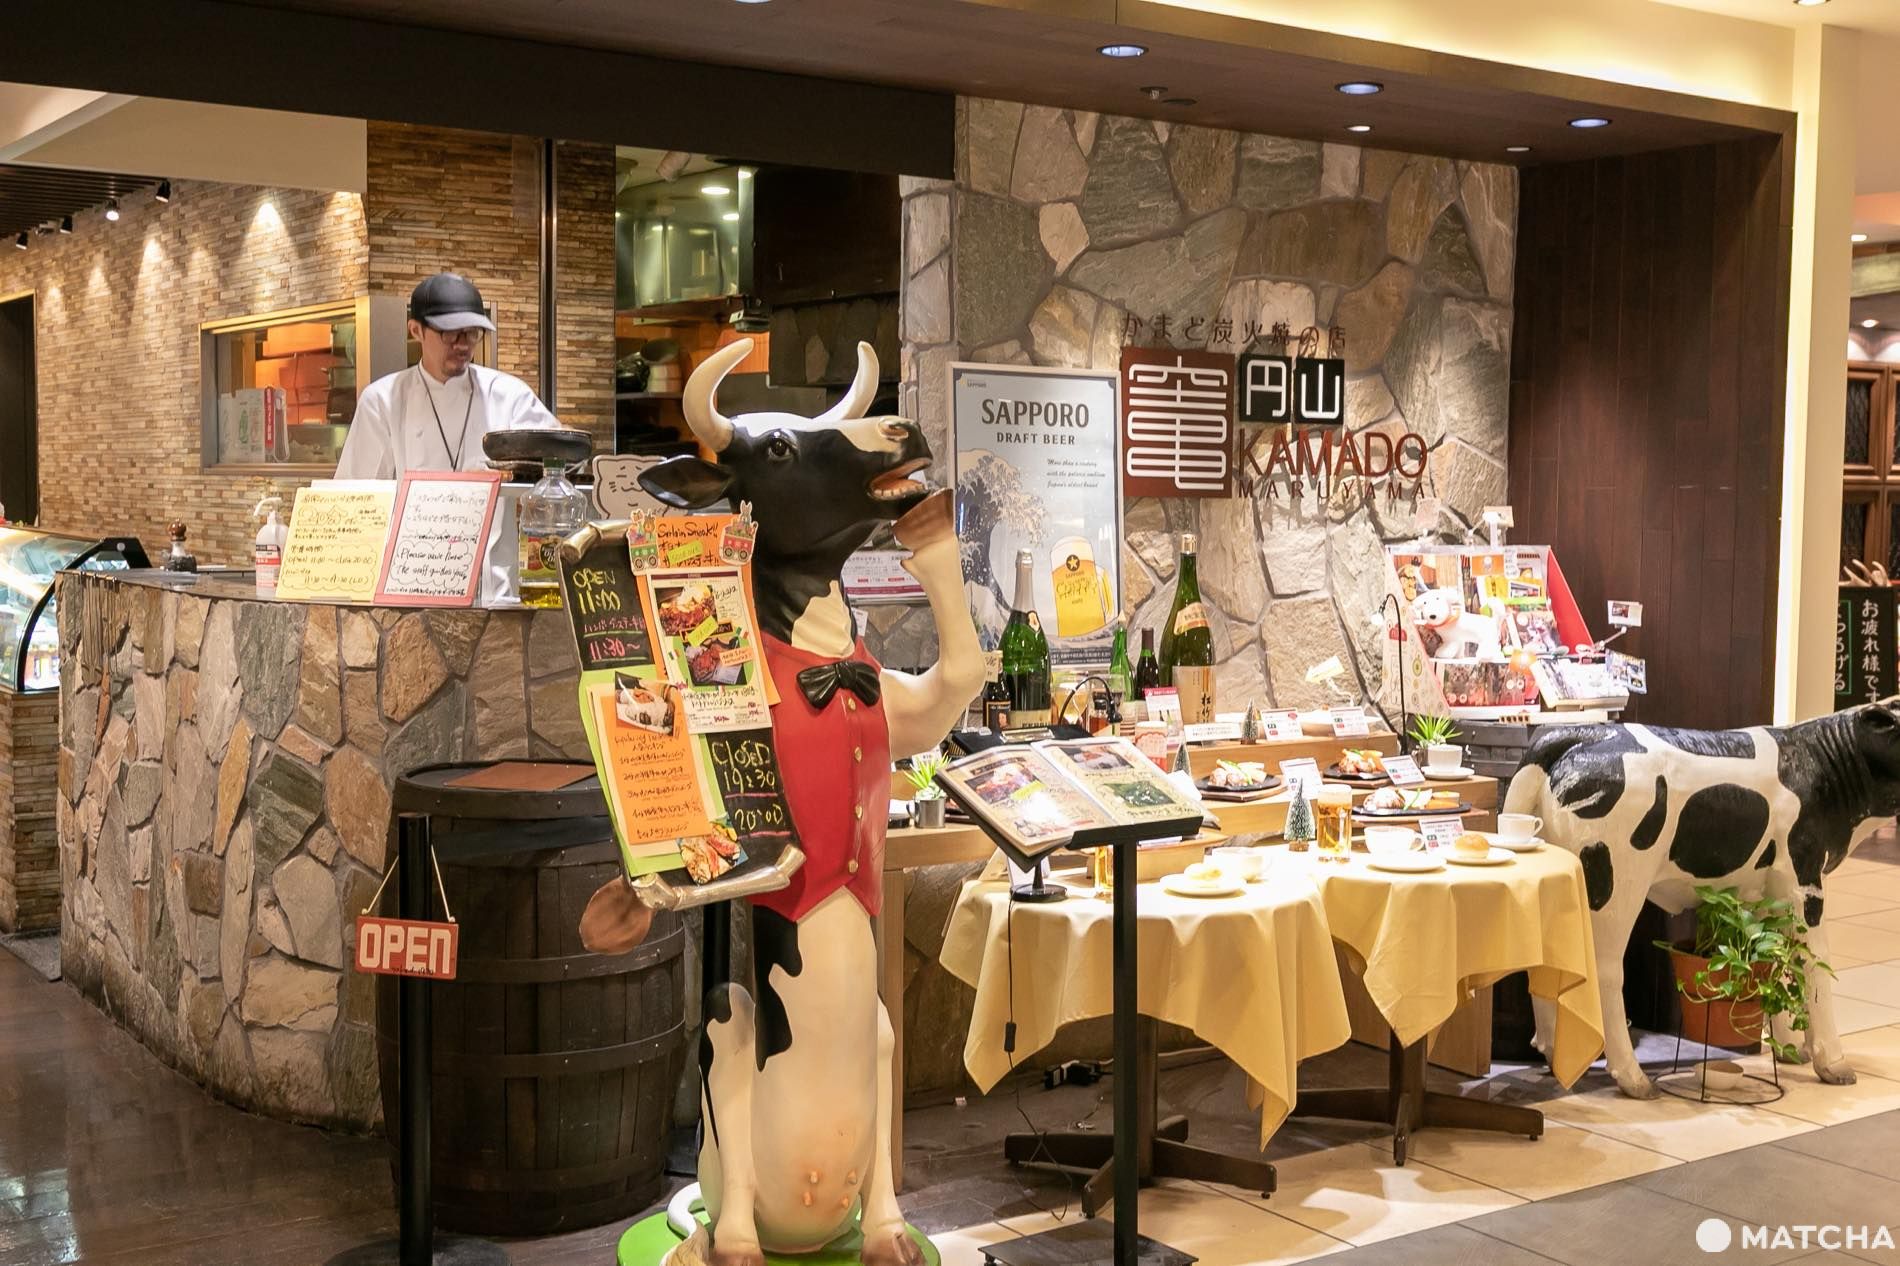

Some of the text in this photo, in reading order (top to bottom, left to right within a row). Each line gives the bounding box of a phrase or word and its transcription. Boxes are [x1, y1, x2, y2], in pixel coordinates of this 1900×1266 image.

[1122, 313, 1347, 350] かまど炭火焼の店
[1245, 359, 1341, 419] 円山
[981, 398, 1090, 429] SAPPORO
[996, 432, 1076, 445] DRAFT BEER
[1238, 428, 1428, 478] KAMADO
[1238, 479, 1426, 499] MARUYAMA
[573, 568, 616, 591] OPEN
[1860, 599, 1881, 704] お疲れ様です
[723, 767, 776, 794] 19:30
[359, 923, 452, 975] OPEN
